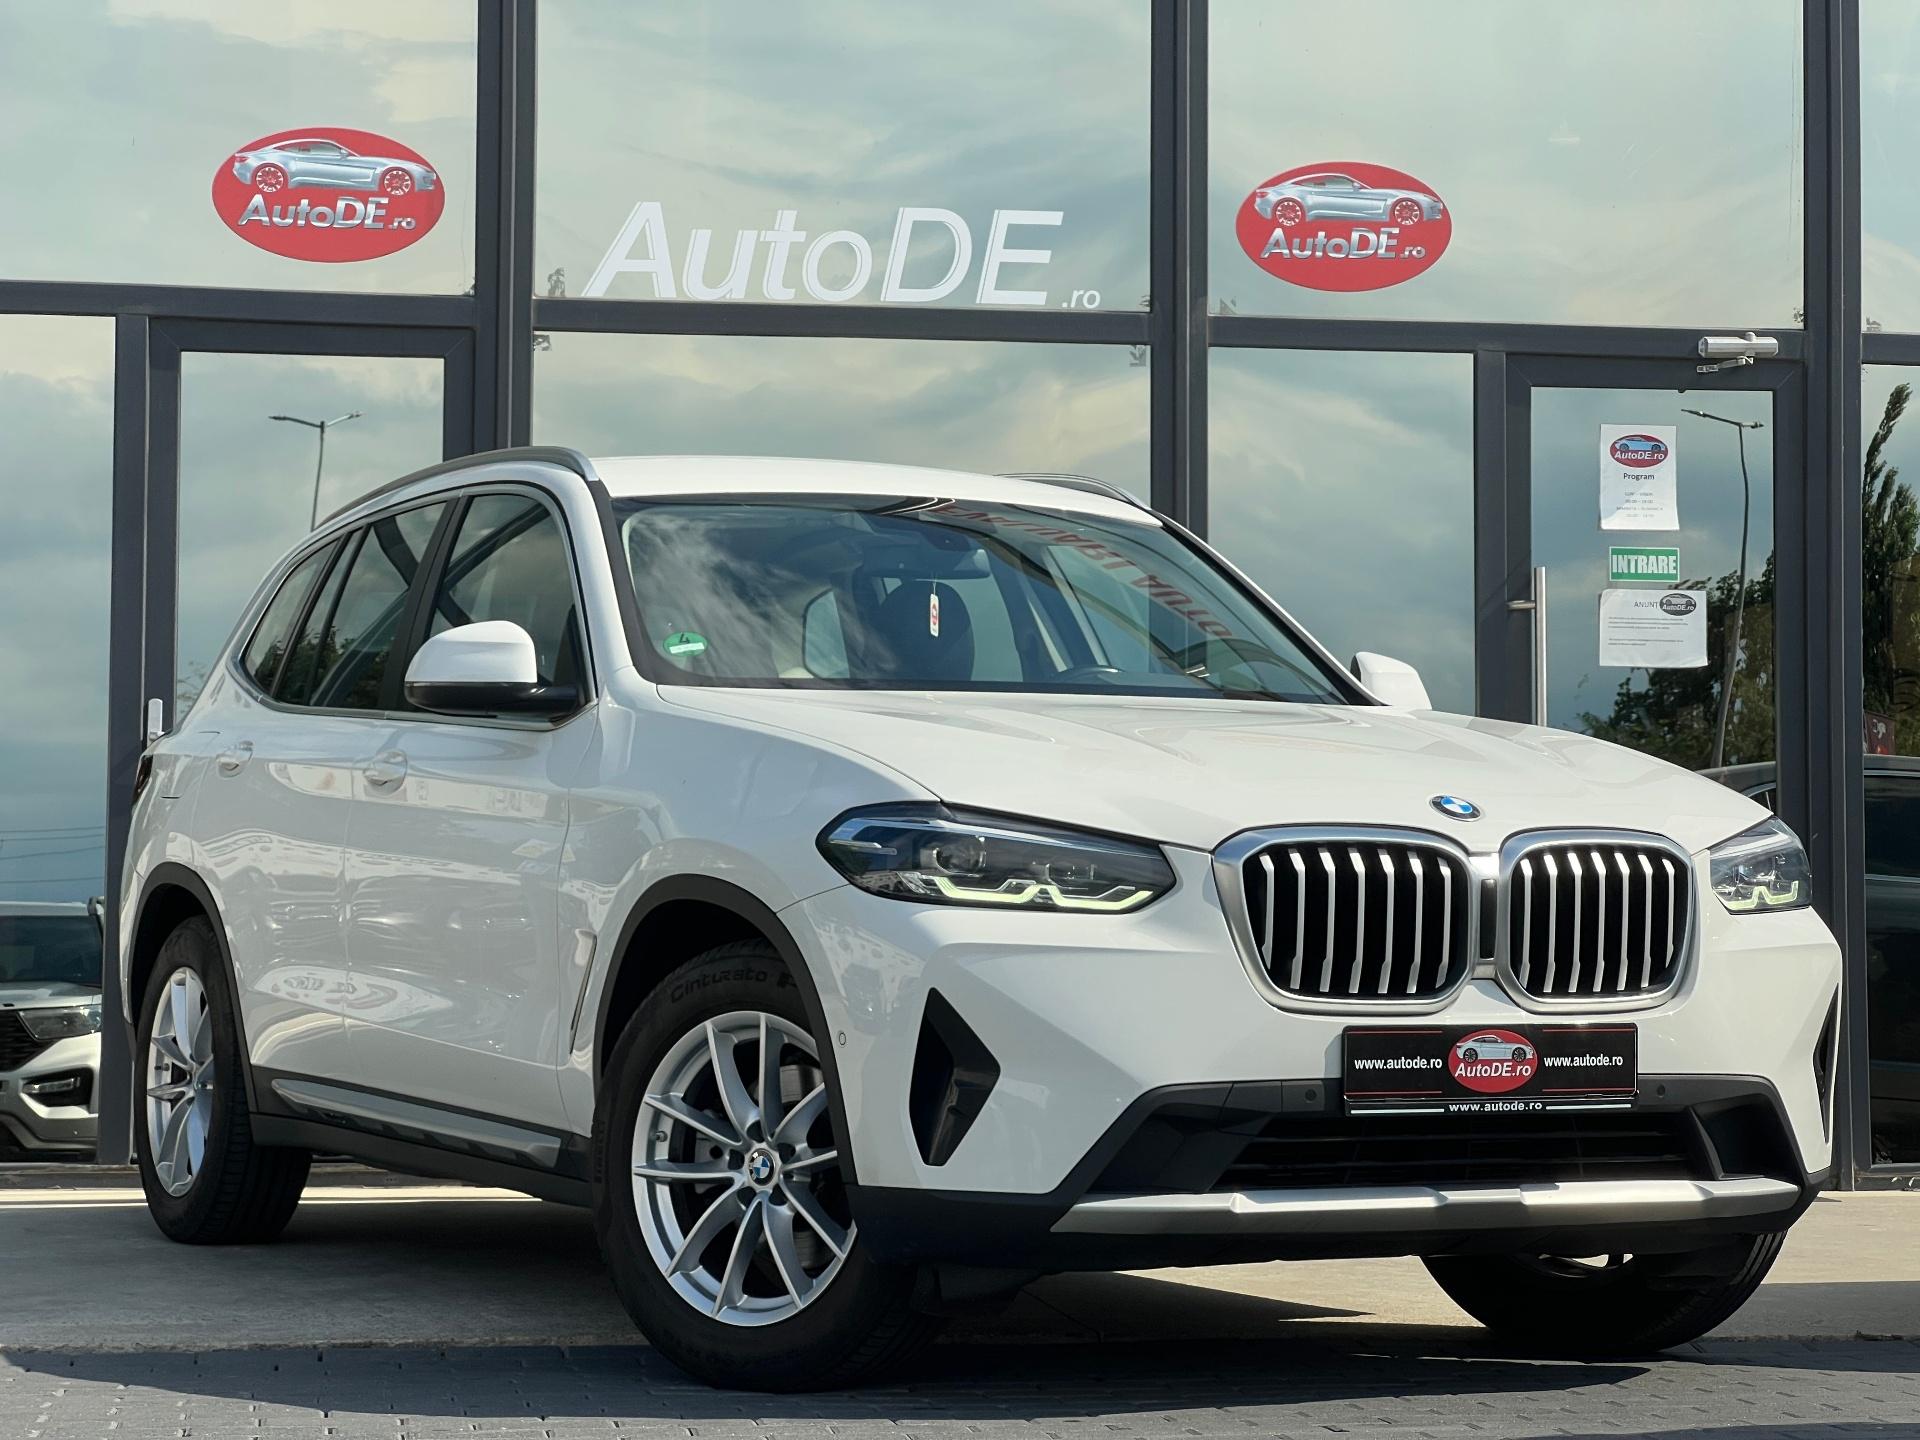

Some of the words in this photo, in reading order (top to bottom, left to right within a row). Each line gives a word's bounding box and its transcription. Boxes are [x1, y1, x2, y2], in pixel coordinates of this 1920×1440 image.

[238, 194, 416, 230] AutoDE.ro
[1259, 227, 1426, 259] AutoDE.ro
[1614, 450, 1665, 460] AutoDE.ro
[1623, 472, 1655, 482] Program
[1612, 554, 1677, 574] INTRARE
[679, 632, 691, 644] 4
[1354, 1056, 1443, 1070] www.autode.ro
[1544, 1054, 1624, 1067] www.autode.ro
[1455, 1062, 1532, 1078] AutoDE.ro
[1449, 1101, 1543, 1112] www.autode.ro
